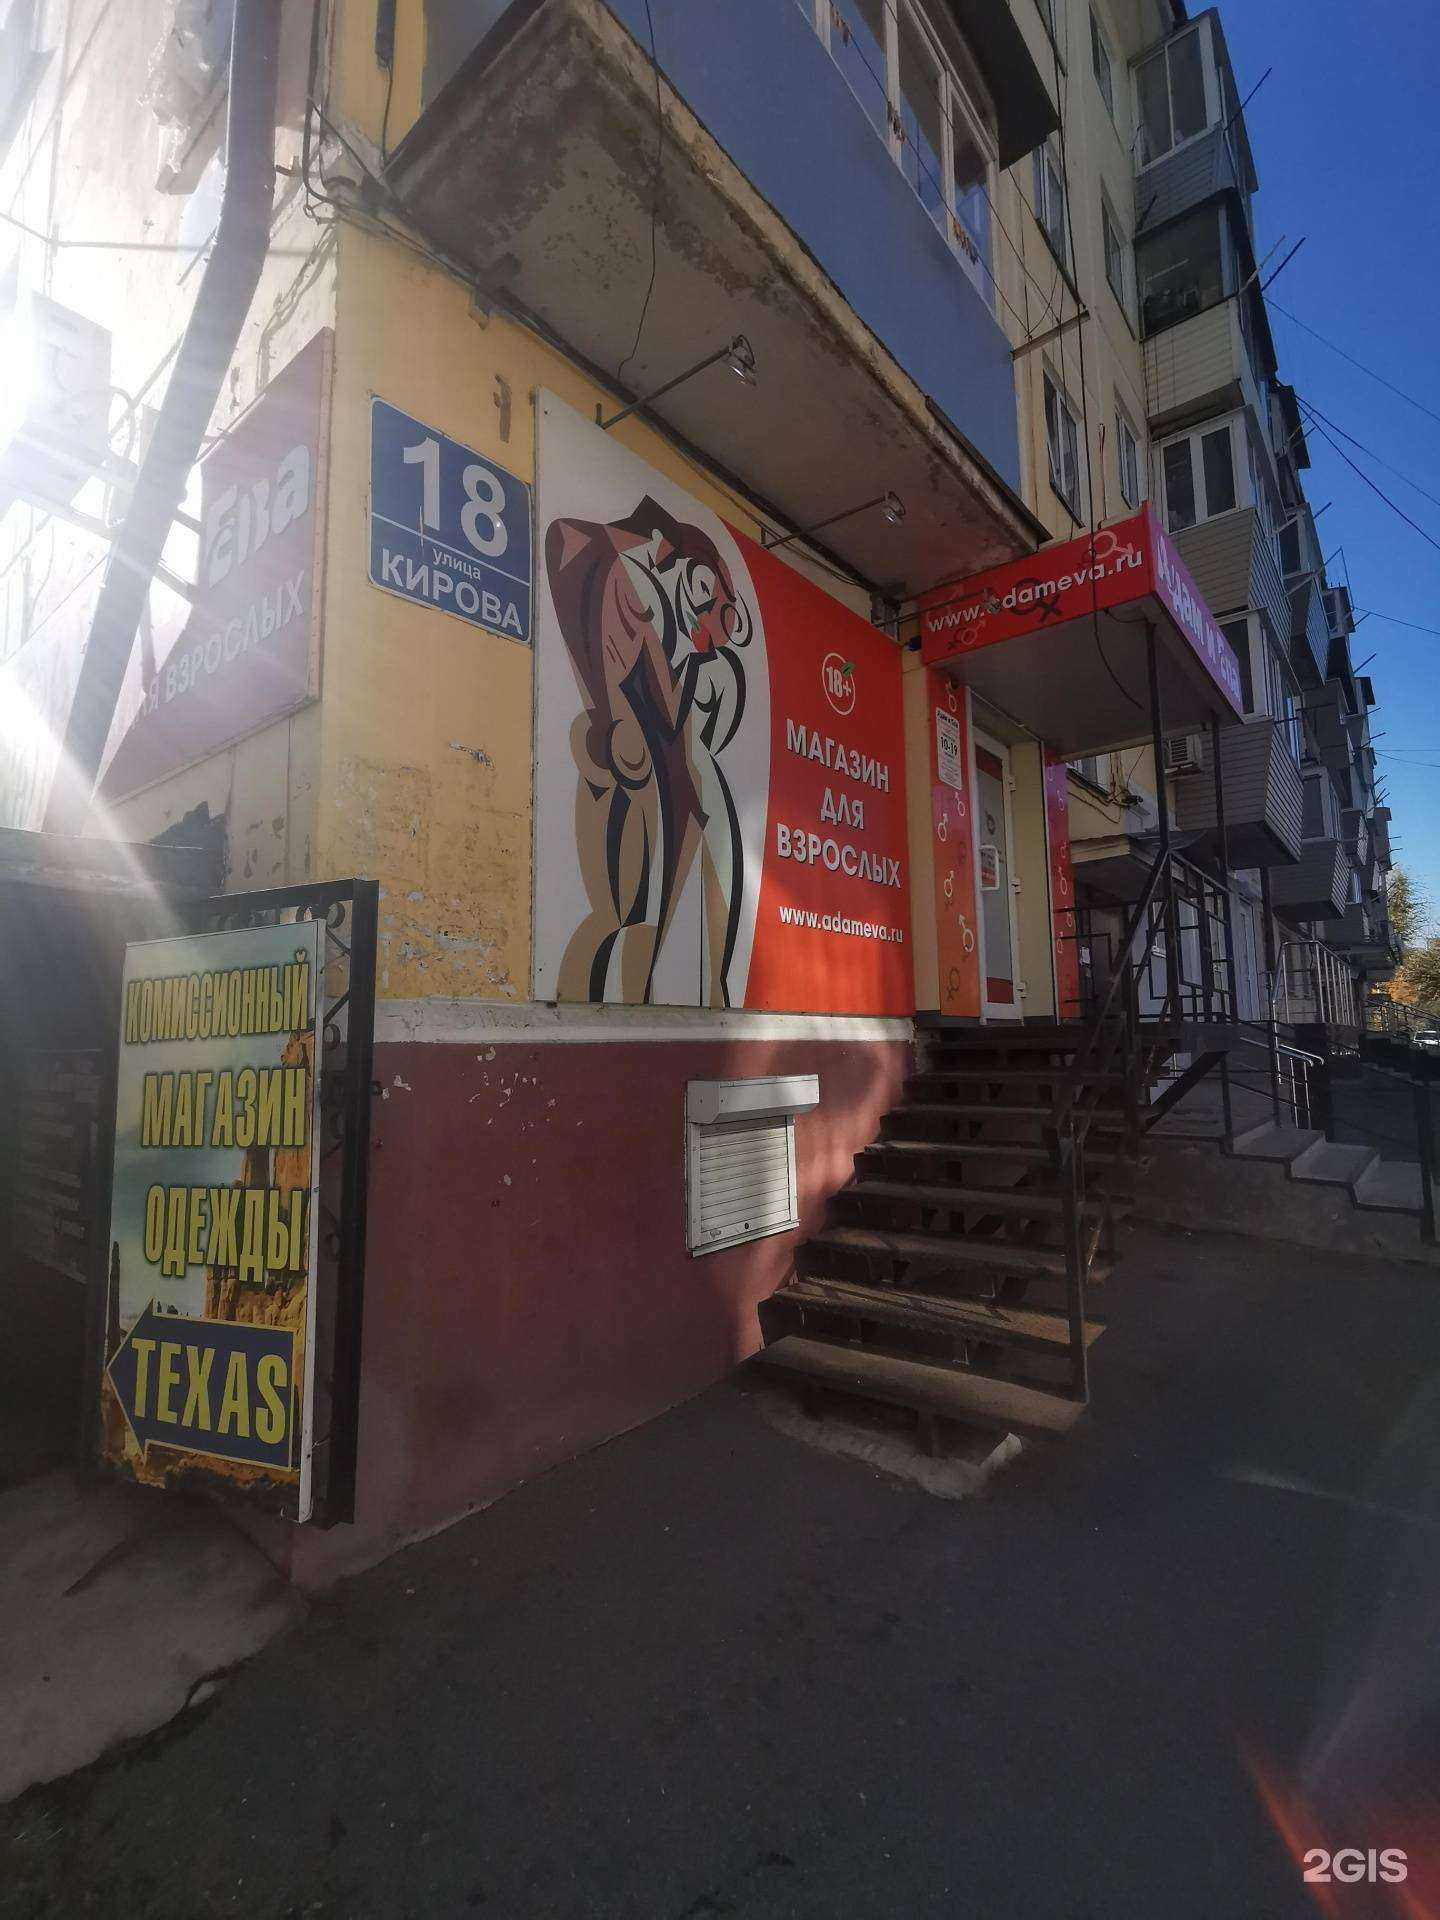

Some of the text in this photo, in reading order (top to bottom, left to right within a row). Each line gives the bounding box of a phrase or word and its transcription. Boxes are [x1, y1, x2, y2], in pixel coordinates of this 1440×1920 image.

[403, 436, 508, 557] 18
[382, 548, 523, 635] КИРОВА
[432, 548, 481, 580] улица
[164, 569, 304, 702] ВЗРОСЛЫХ
[826, 666, 852, 697] 18+
[786, 718, 889, 793] МАГАЗИН
[820, 787, 864, 829] ДЛЯ
[777, 823, 901, 888] ВЗРОСЛЫХ
[779, 905, 904, 943] www.adameva.ru
[125, 950, 310, 1044] КОМИССИОННЫЙ
[141, 1067, 306, 1147] МАГАЗИН
[143, 1184, 303, 1283] ОДЕЖДЫ
[131, 1338, 289, 1446] TEXAS
